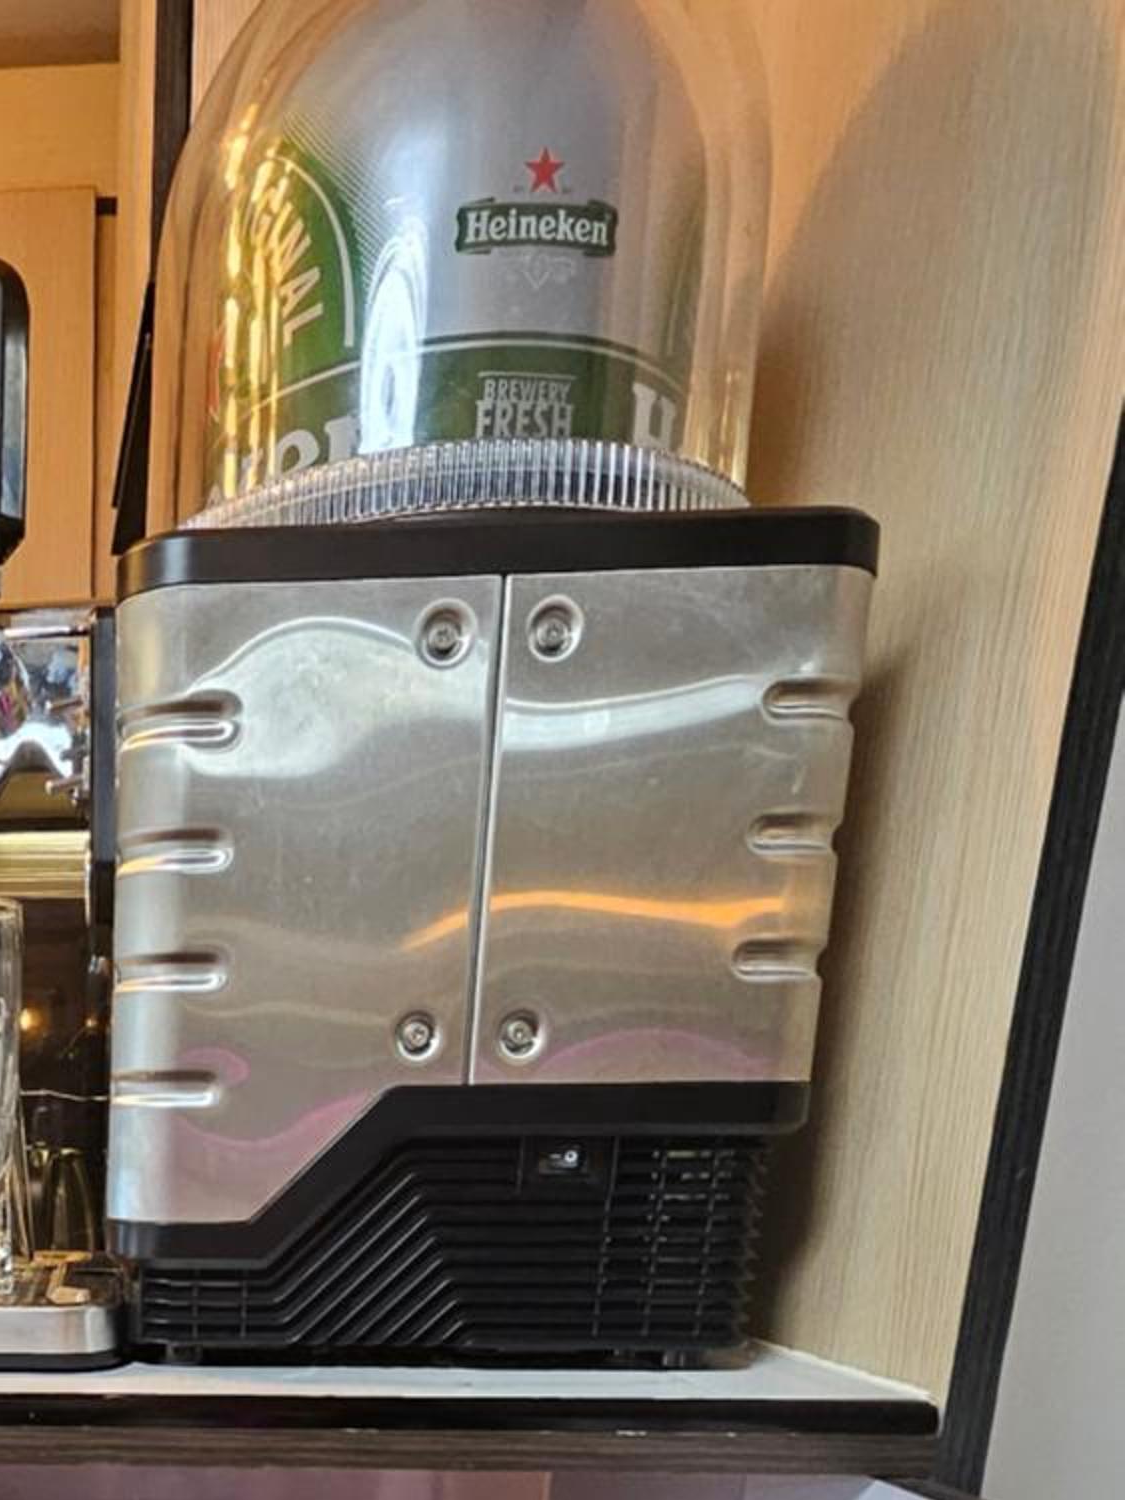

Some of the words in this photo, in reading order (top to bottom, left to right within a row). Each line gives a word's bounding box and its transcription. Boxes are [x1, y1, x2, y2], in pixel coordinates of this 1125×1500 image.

[464, 208, 608, 246] Heineken
[483, 378, 572, 404] BREWERY
[476, 400, 574, 439] FRESH
